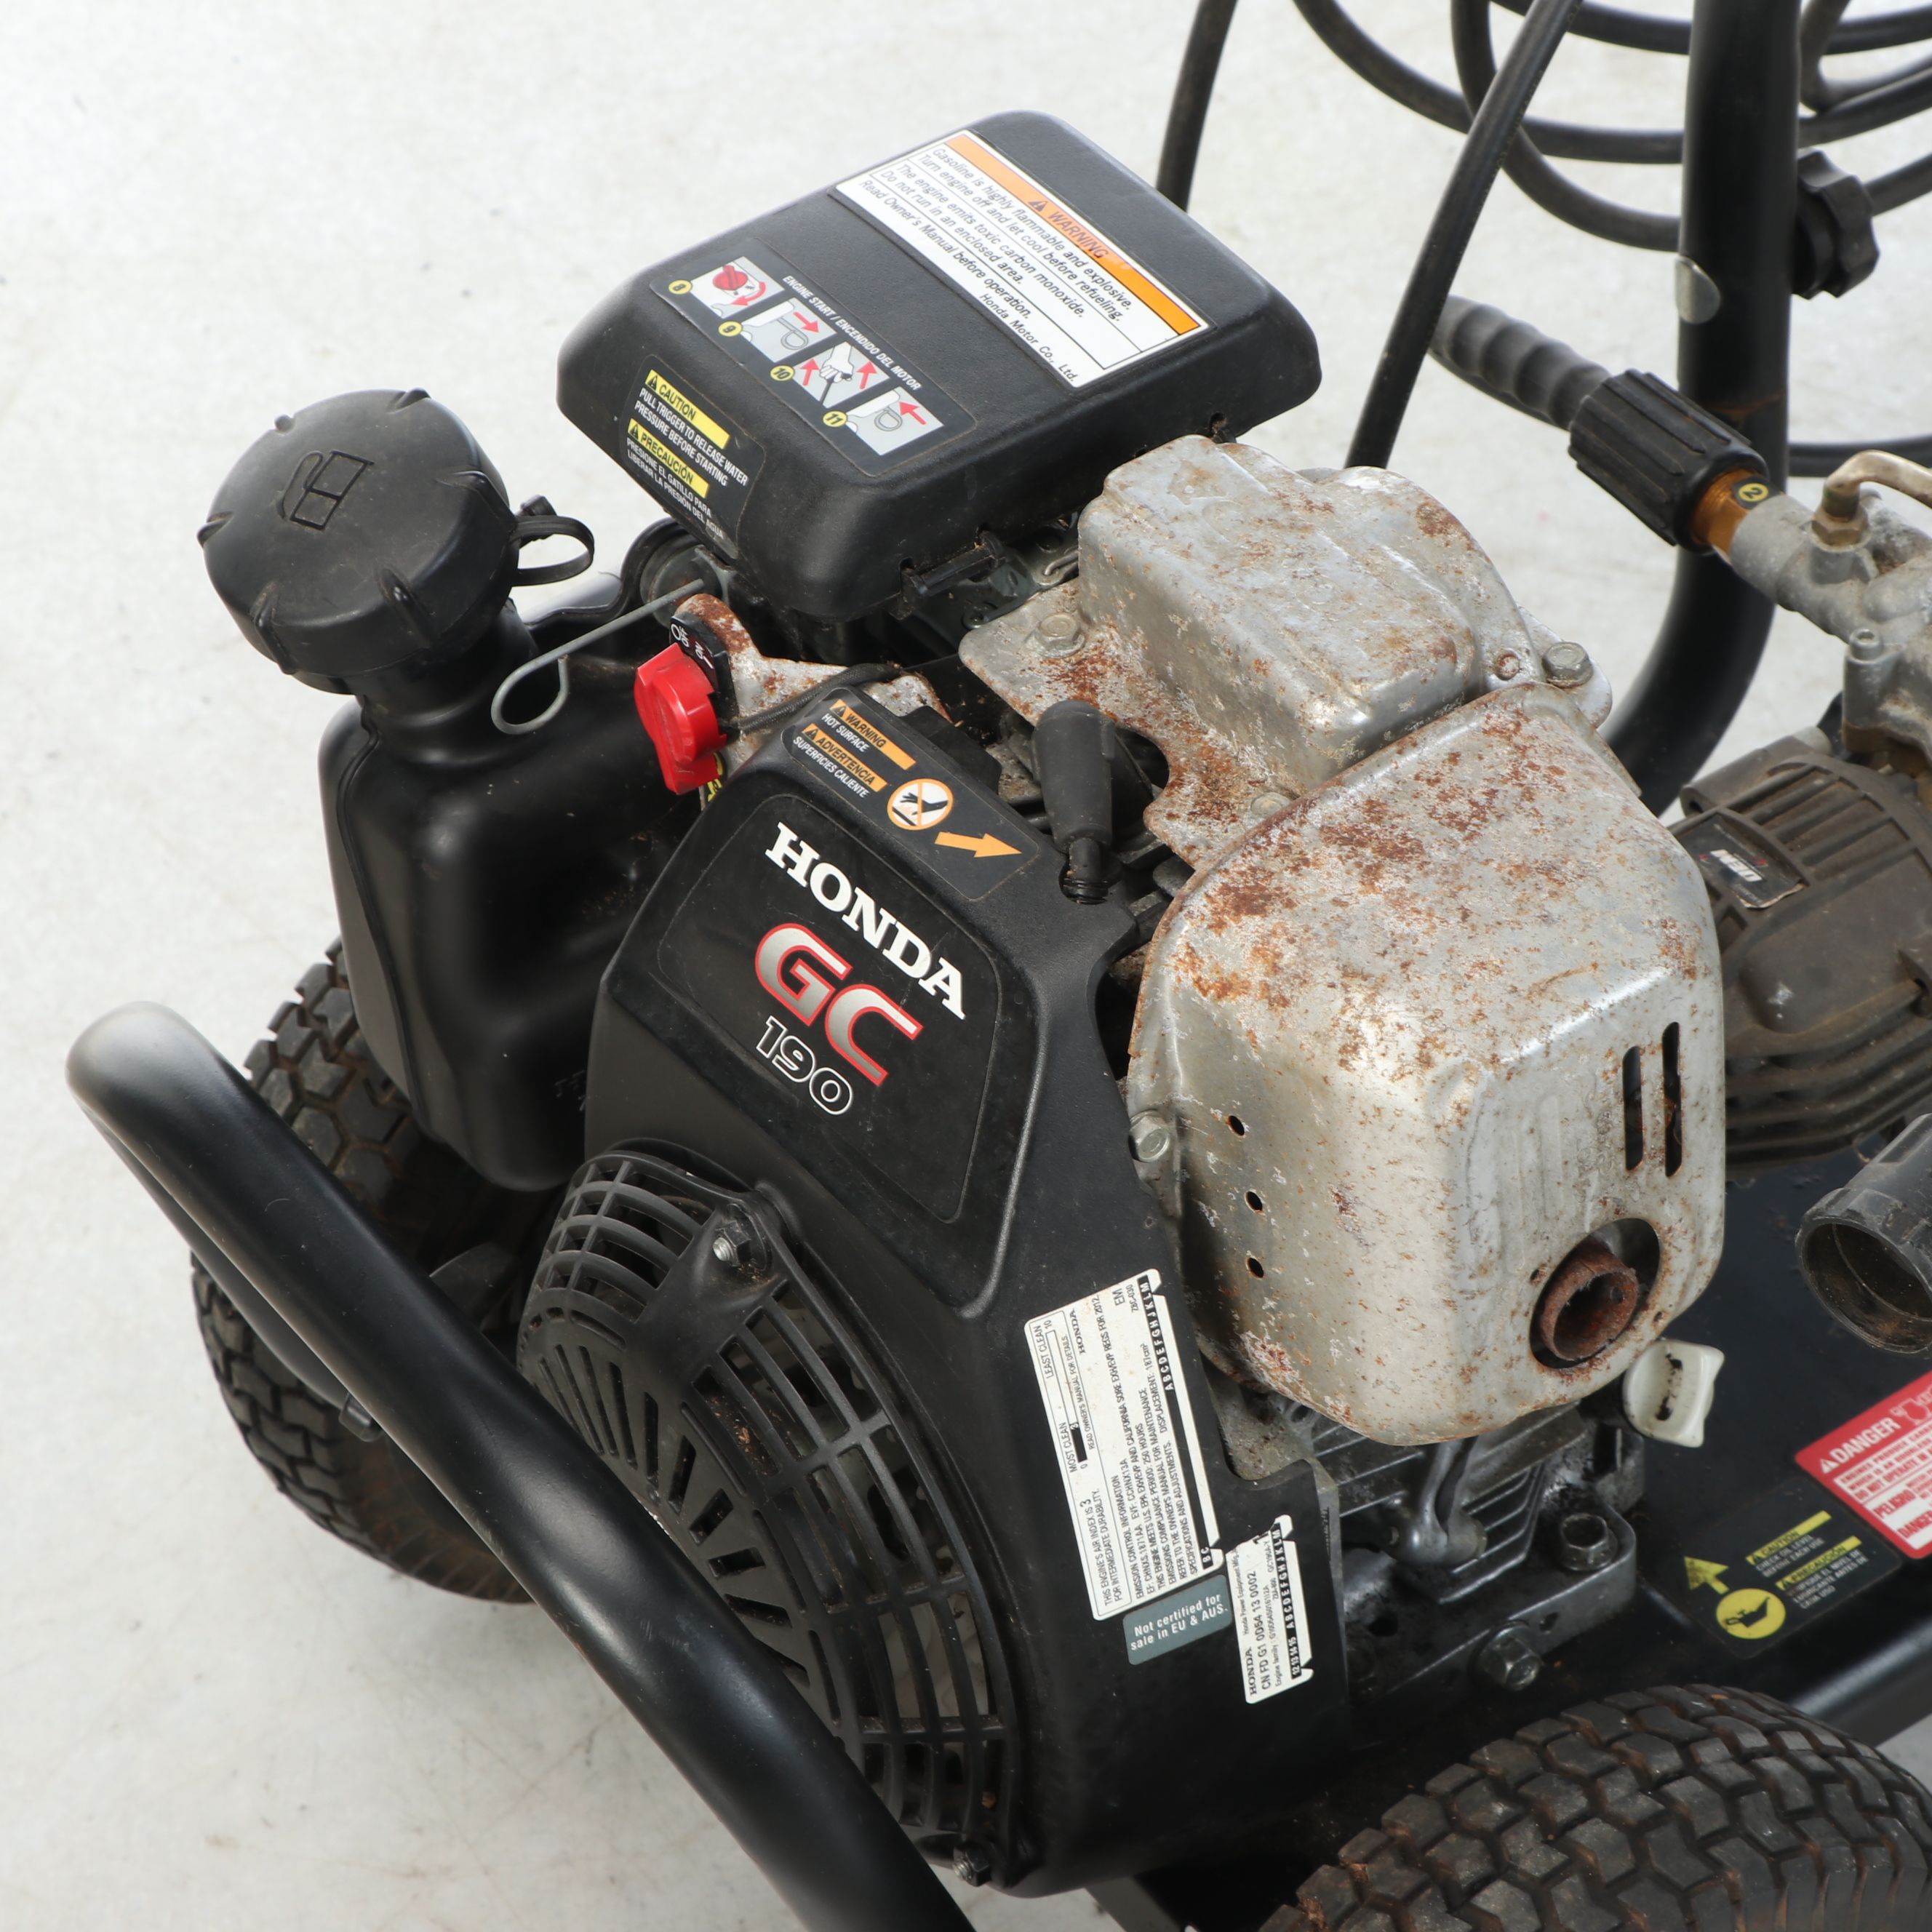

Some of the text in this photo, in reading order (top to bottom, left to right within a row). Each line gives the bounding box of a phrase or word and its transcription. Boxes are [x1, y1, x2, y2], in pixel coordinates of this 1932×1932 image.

[880, 169, 1023, 284] Do not run in an enclosed area.
[897, 164, 1084, 317] The engine emits toxic carbon monoxide.
[919, 153, 1122, 321] Turn engine off and let cool before refueling.
[932, 148, 1131, 310] Gasoline is highly flammable and explosive.
[1048, 211, 1109, 259] WARNING
[860, 180, 1031, 319] Read Owner's Manual before operation.
[783, 275, 921, 390] ENGINE START ENCENDIDO DEL MOTOR
[979, 293, 1078, 381] Honda Motor Co., Ltd.
[773, 367, 790, 380] 10
[658, 383, 696, 420] CAUTION
[826, 413, 843, 426] 11
[634, 400, 727, 486] PRESSURE BEFORE STARTING
[639, 387, 748, 485] PULL TRIGGER TO RELEASE WATER
[626, 437, 711, 518] PRESIONE EL GATILLO PARA
[640, 432, 693, 484] PRECAUCIÓN
[627, 449, 653, 478] LIBERAR
[653, 472, 663, 487] LA
[663, 481, 691, 511] PRESIÓN
[692, 506, 705, 523] DEL
[1742, 486, 1763, 500] 2
[678, 625, 690, 648] OFF
[694, 640, 705, 660] ON
[821, 712, 869, 751] HOT SURFACE
[845, 714, 886, 748] WARNING
[793, 736, 869, 797] SUPERFICIES CALIENTE
[815, 737, 874, 784] ADVERTENCIA
[765, 821, 965, 1020] HONDA
[754, 922, 924, 1087] GC
[755, 1015, 854, 1115] 190
[1111, 1288, 1125, 1306] EM
[1043, 1319, 1052, 1329] 10
[1069, 1309, 1085, 1354] HONDA
[1095, 1314, 1106, 1331] FOR
[1100, 1330, 1111, 1352] REGS
[1033, 1325, 1054, 1378] LEAST CLEAN
[1067, 1361, 1076, 1375] FOR
[1105, 1352, 1119, 1383] EXH/EVP
[1071, 1375, 1083, 1402] MANUAL
[1113, 1383, 1125, 1403] SORE
[1146, 1375, 1167, 1433] DISPLACEMENT:
[1078, 1403, 1090, 1432] OWNER'S
[1118, 1403, 1135, 1445] CALIFORNIA
[1058, 1421, 1077, 1473] MOST CLEAN
[1085, 1432, 1095, 1450] READ
[1127, 1446, 1139, 1463] AND
[1830, 1417, 1900, 1462] DANGER
[1119, 1458, 1135, 1501] CCHNX13A
[1132, 1464, 1146, 1493] EXH/EVP
[1138, 1388, 1187, 1579] REFER TO THE OWNER'S MANUAL FOR MAINTENANCE
[1162, 1442, 1182, 1498] ADJUSTMENTS.
[1134, 1422, 1176, 1584] EMISSIONS COMPLIANCE PERIOD: 250 HOURS
[1138, 1493, 1149, 1509] EPA
[1175, 1499, 1186, 1516] AND
[1872, 1490, 1915, 1517] PELIGRO
[1079, 1498, 1111, 1606] THIS ENGINE'S AIR INDEX IS 3
[1091, 1490, 1122, 1602] FOR INTERMEDIATE DURABILITY.
[1111, 1474, 1144, 1599] EMISSION CONTROL INFORMATION
[1145, 1522, 1157, 1547] MEETS
[1179, 1517, 1197, 1574] SPECIFICATIONS
[1760, 1532, 1800, 1556] CAUTION
[1150, 1548, 1162, 1573] ENGINE
[1155, 1573, 1165, 1589] THIS
[1246, 1570, 1258, 1598] 0002
[1130, 1602, 1227, 1650] sale in EU & AUS.
[1133, 1594, 1220, 1637] Not certified for
[1250, 1599, 1261, 1613] 13
[1245, 1648, 1257, 1695] HONDA
[1257, 1643, 1267, 1658] G1
[1258, 1658, 1269, 1673] FD
[1271, 1644, 1282, 1687] Engine family
[1261, 1674, 1271, 1690] CN
